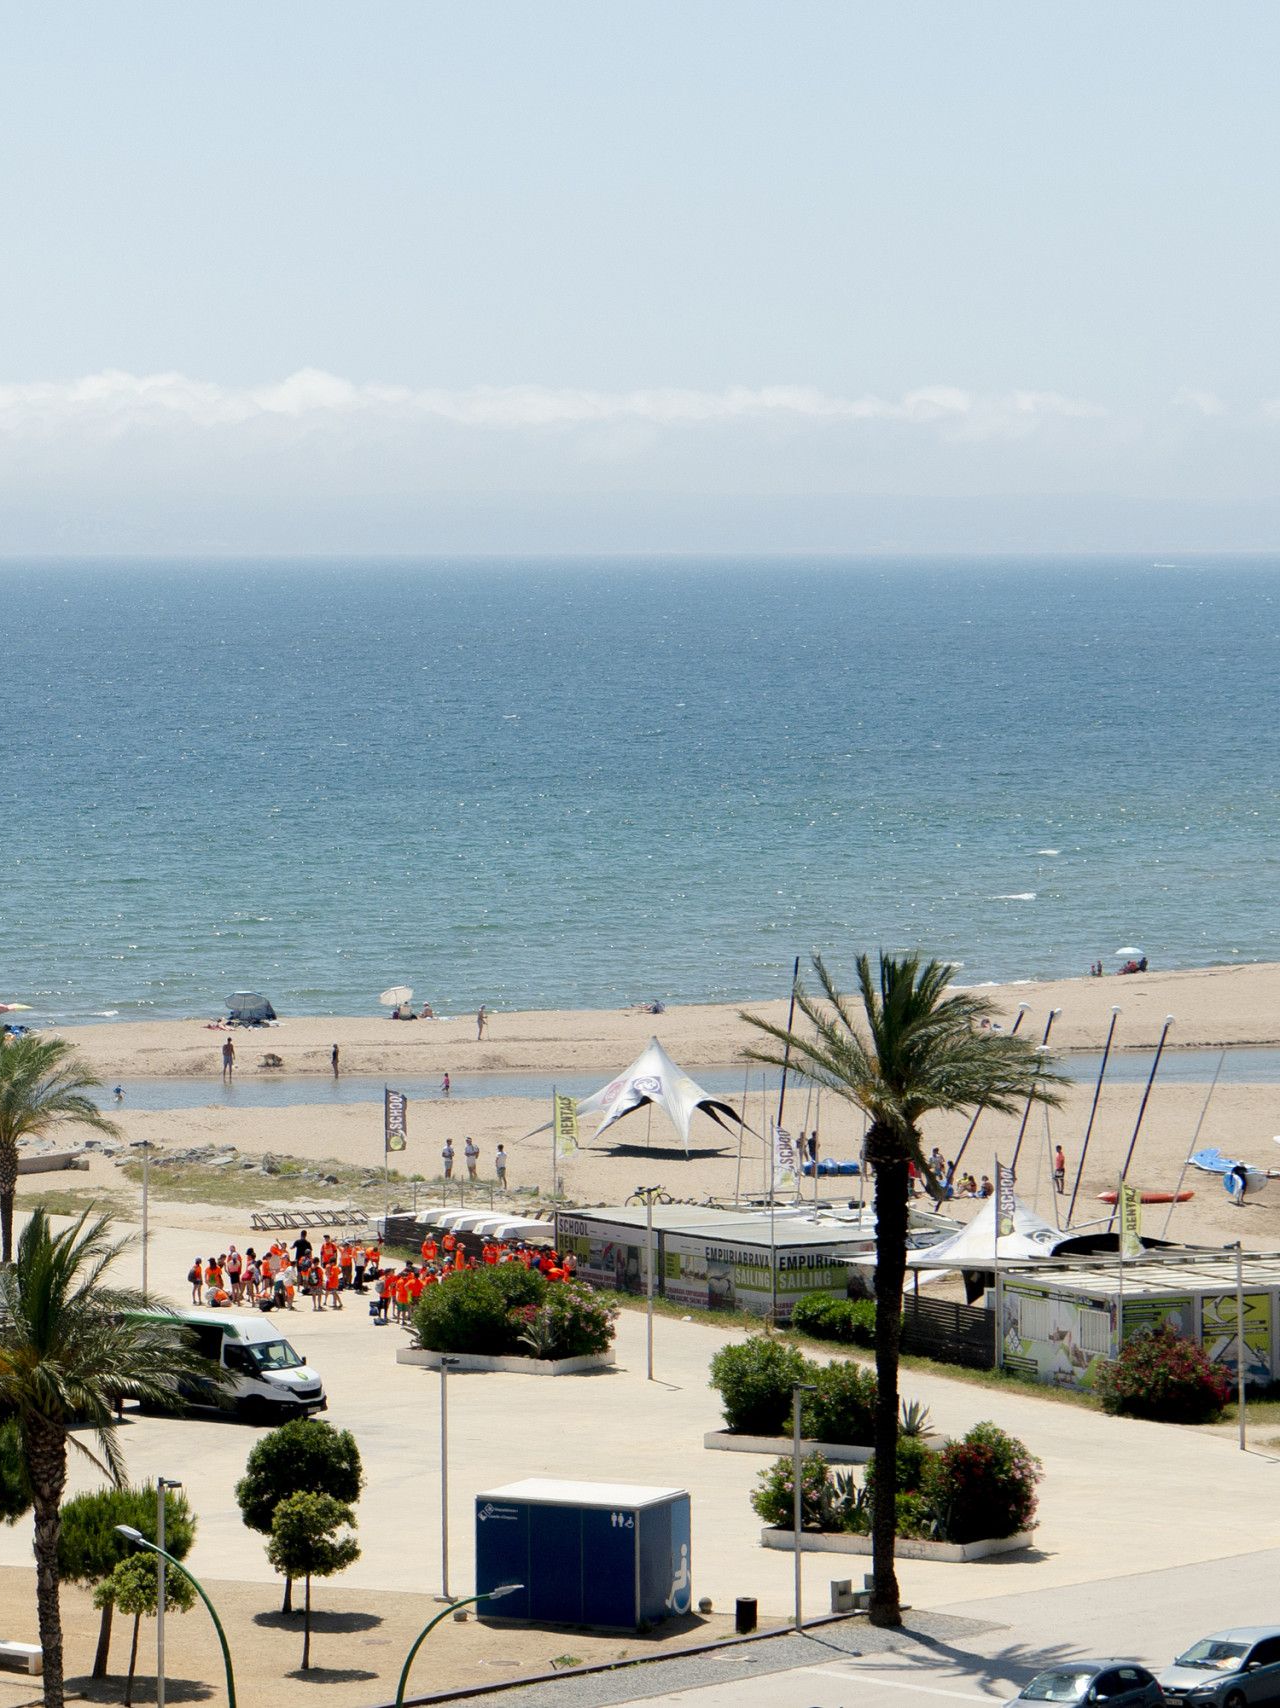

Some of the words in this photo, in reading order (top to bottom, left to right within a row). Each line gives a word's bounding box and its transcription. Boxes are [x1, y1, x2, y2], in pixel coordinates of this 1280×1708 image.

[559, 1218, 589, 1236] SCHOOL
[559, 1234, 578, 1250] RENT
[705, 1246, 771, 1268] EMPURIABRAVA
[735, 1268, 770, 1288] SAILING
[779, 1270, 833, 1290] SAILING
